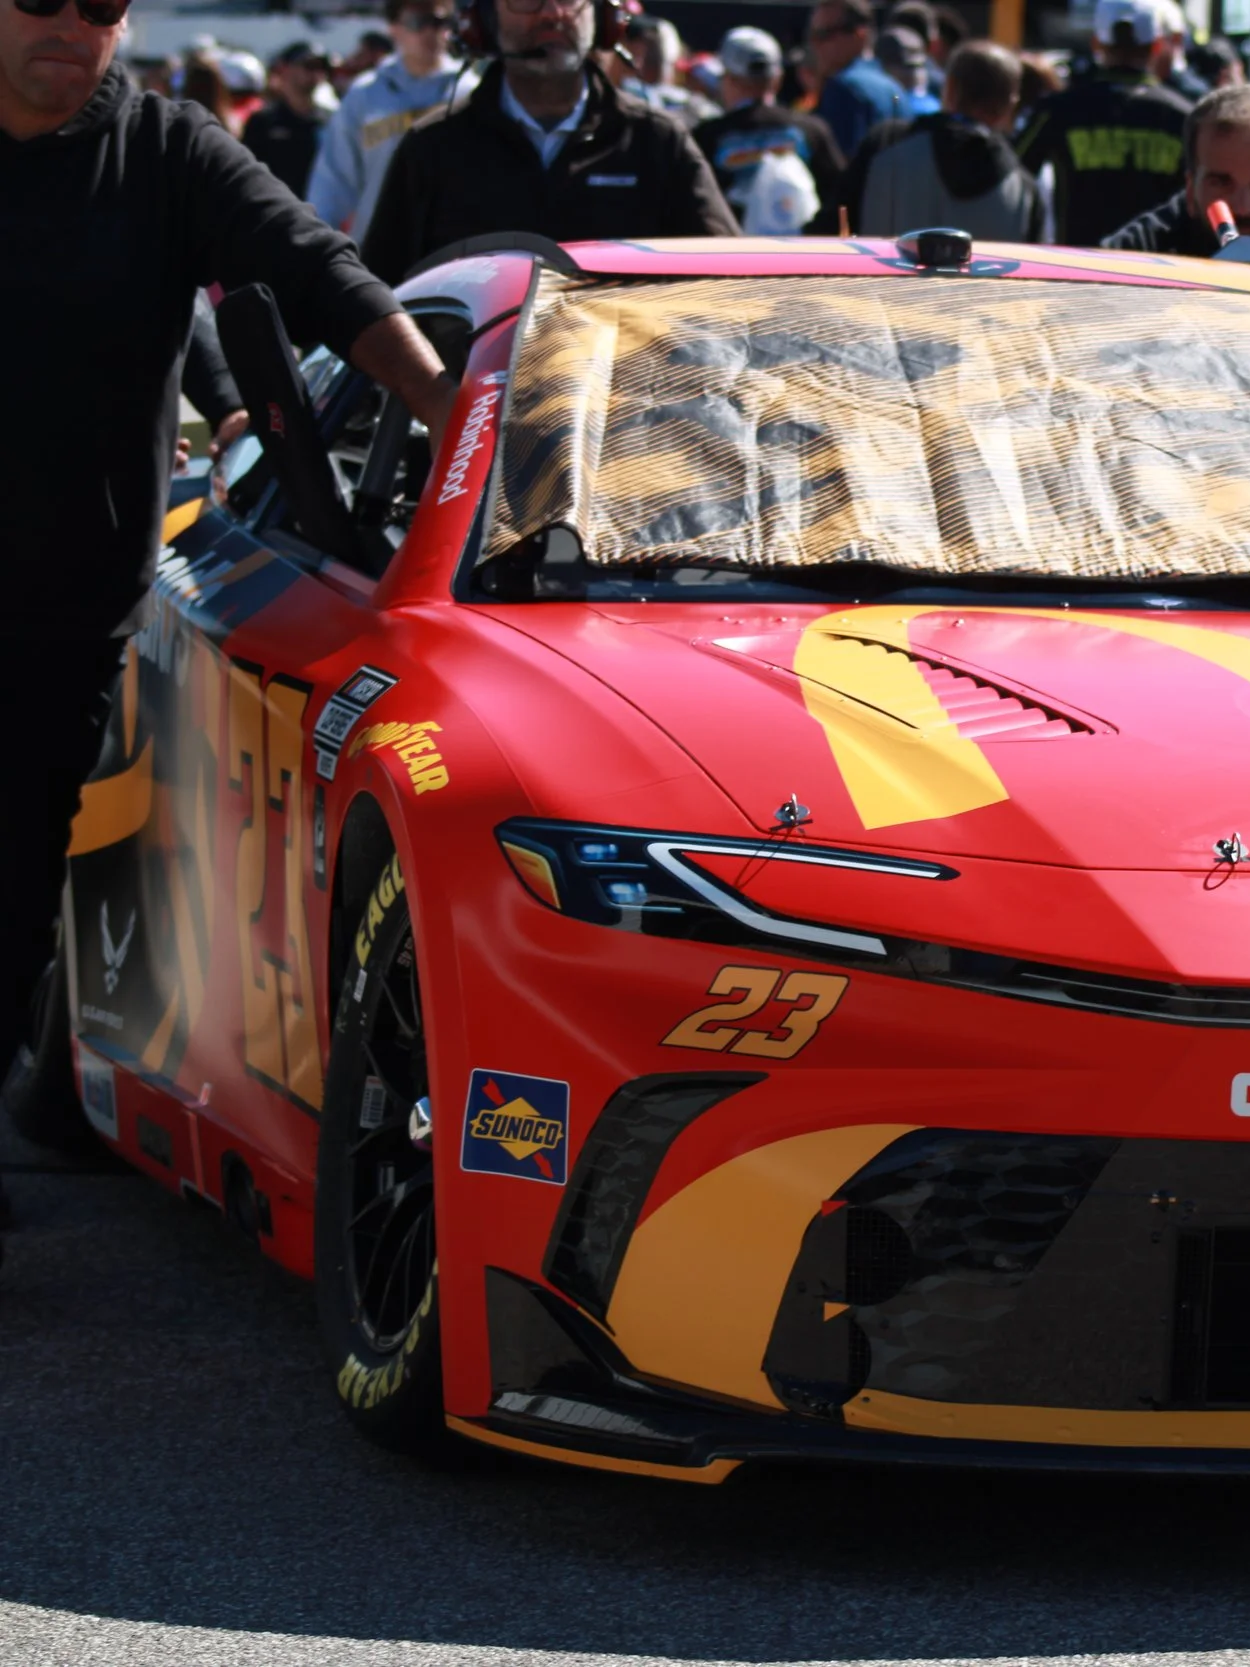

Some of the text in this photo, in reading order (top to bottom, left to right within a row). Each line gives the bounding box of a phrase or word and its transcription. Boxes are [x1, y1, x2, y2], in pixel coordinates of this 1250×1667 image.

[437, 389, 502, 506] Robinhood
[355, 852, 405, 968] EAGL
[657, 963, 851, 1061] 23
[474, 1111, 561, 1147] SUNOCO
